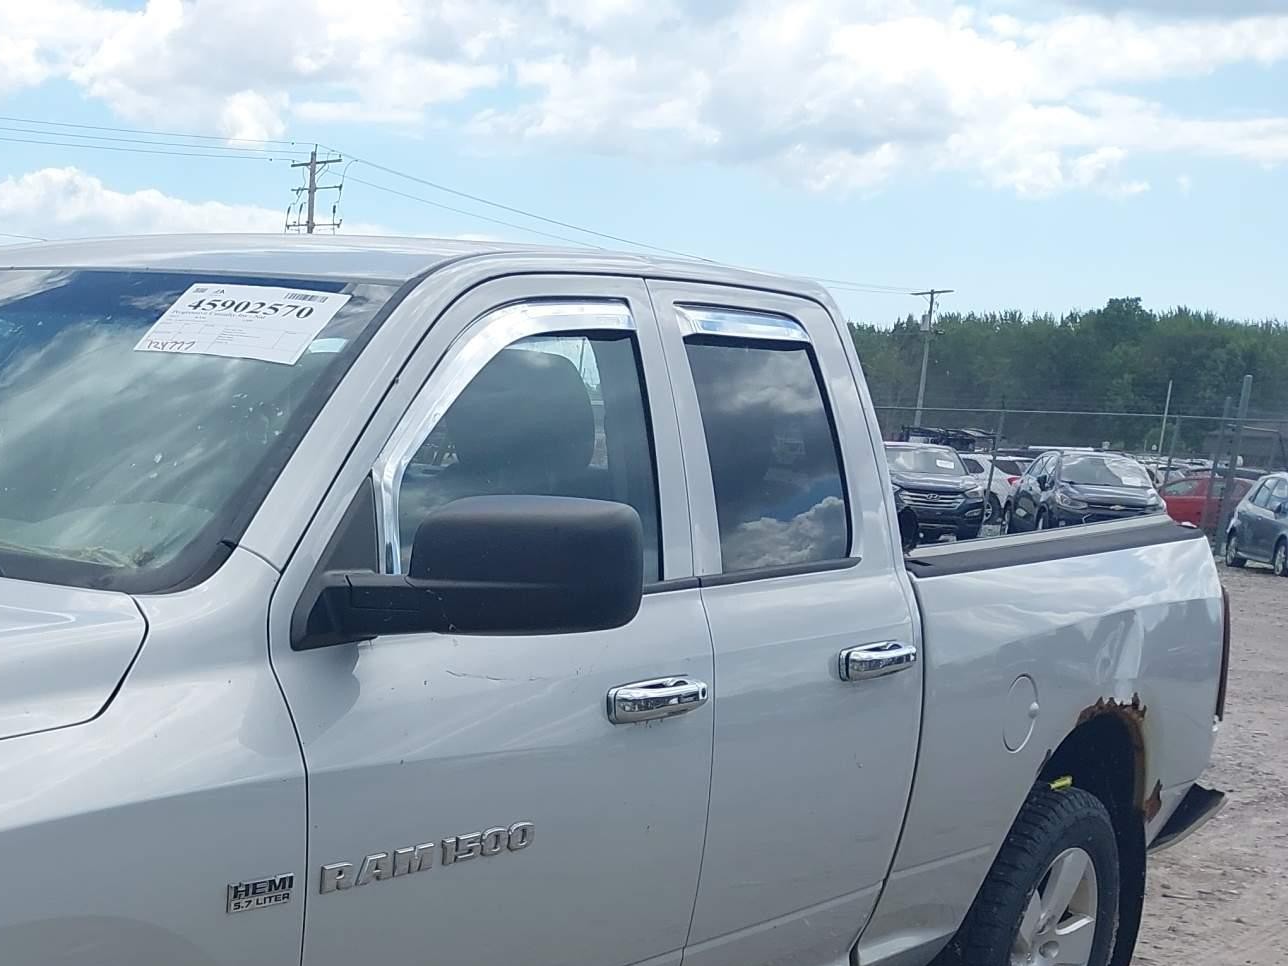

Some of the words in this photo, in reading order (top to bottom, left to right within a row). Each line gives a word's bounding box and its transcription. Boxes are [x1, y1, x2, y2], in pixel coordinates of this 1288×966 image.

[187, 298, 314, 319] 45902570
[319, 842, 435, 895] RAM
[441, 821, 536, 866] 1500
[231, 873, 294, 899] HEMI
[232, 900, 253, 911] 5.7
[255, 892, 290, 906] LITER
